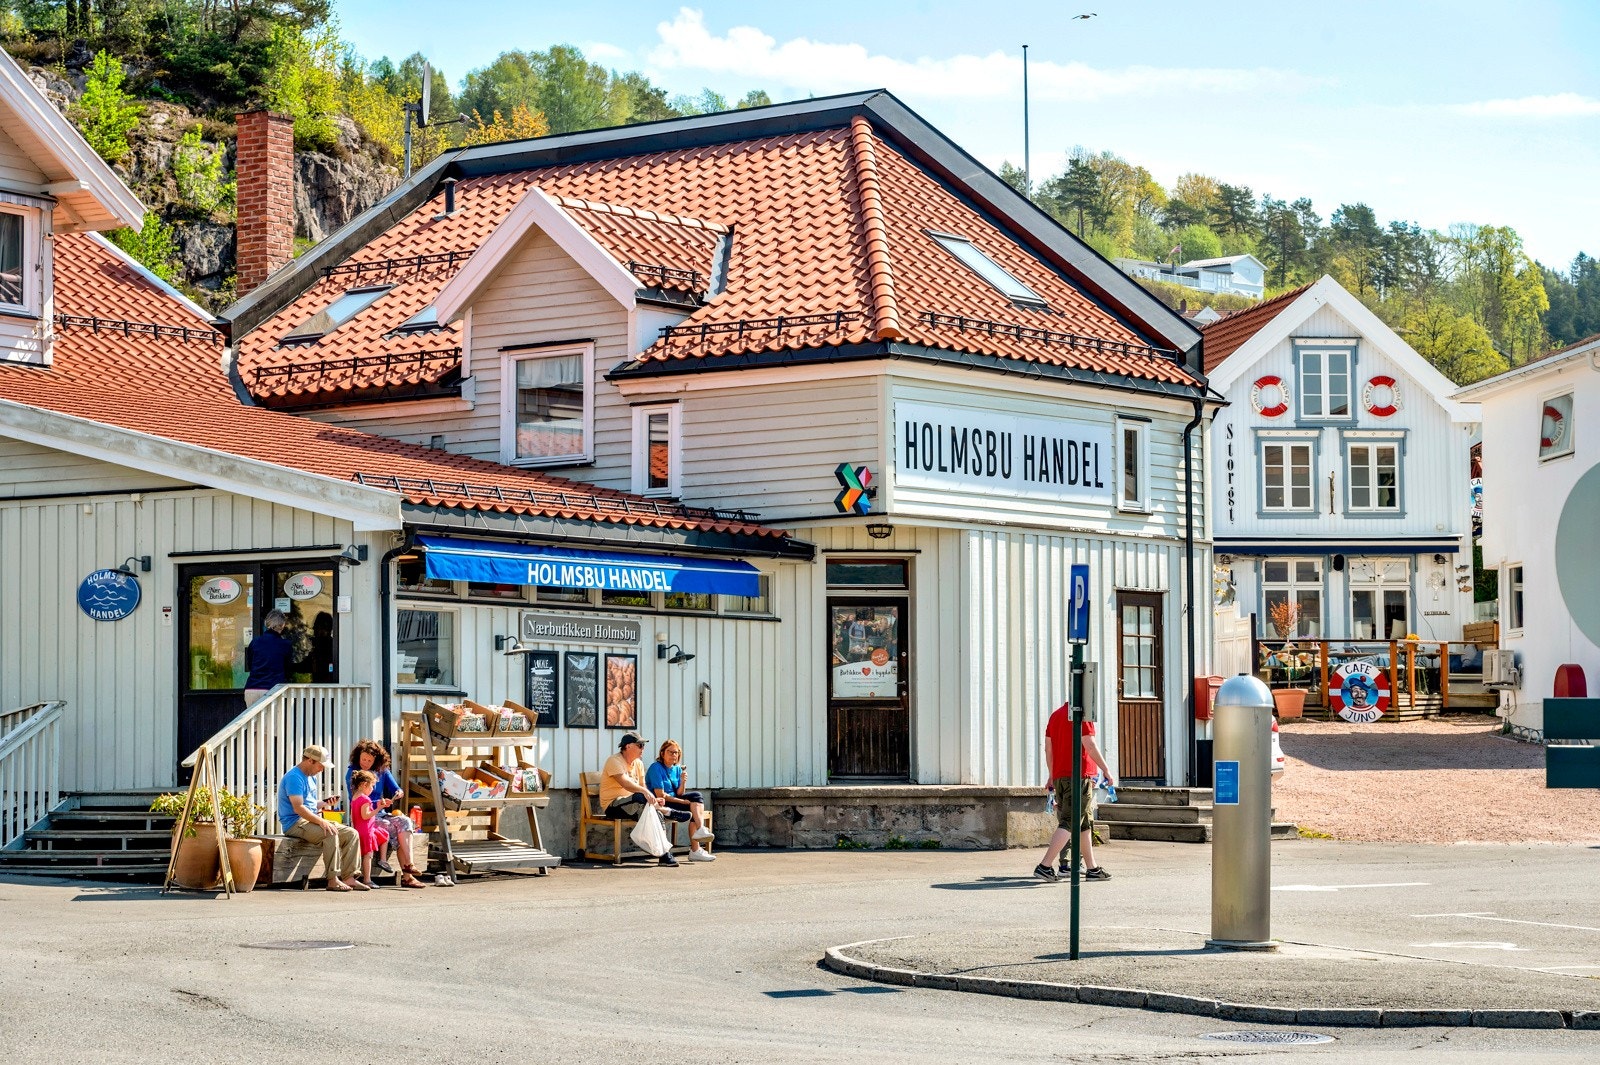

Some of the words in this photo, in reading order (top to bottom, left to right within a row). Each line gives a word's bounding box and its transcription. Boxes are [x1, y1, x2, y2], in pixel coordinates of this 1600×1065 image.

[905, 421, 1012, 479] HOLMSBU
[1023, 434, 1104, 488] HANDEL
[527, 562, 606, 588] HOLMSBU
[608, 567, 672, 591] HANDEL
[1074, 575, 1085, 630] P
[90, 608, 125, 619] HANDEL
[527, 620, 592, 638] Nærbutikken
[594, 624, 637, 641] Holmsbu
[1344, 663, 1372, 675] CAFE
[1345, 710, 1376, 722] JUNO
